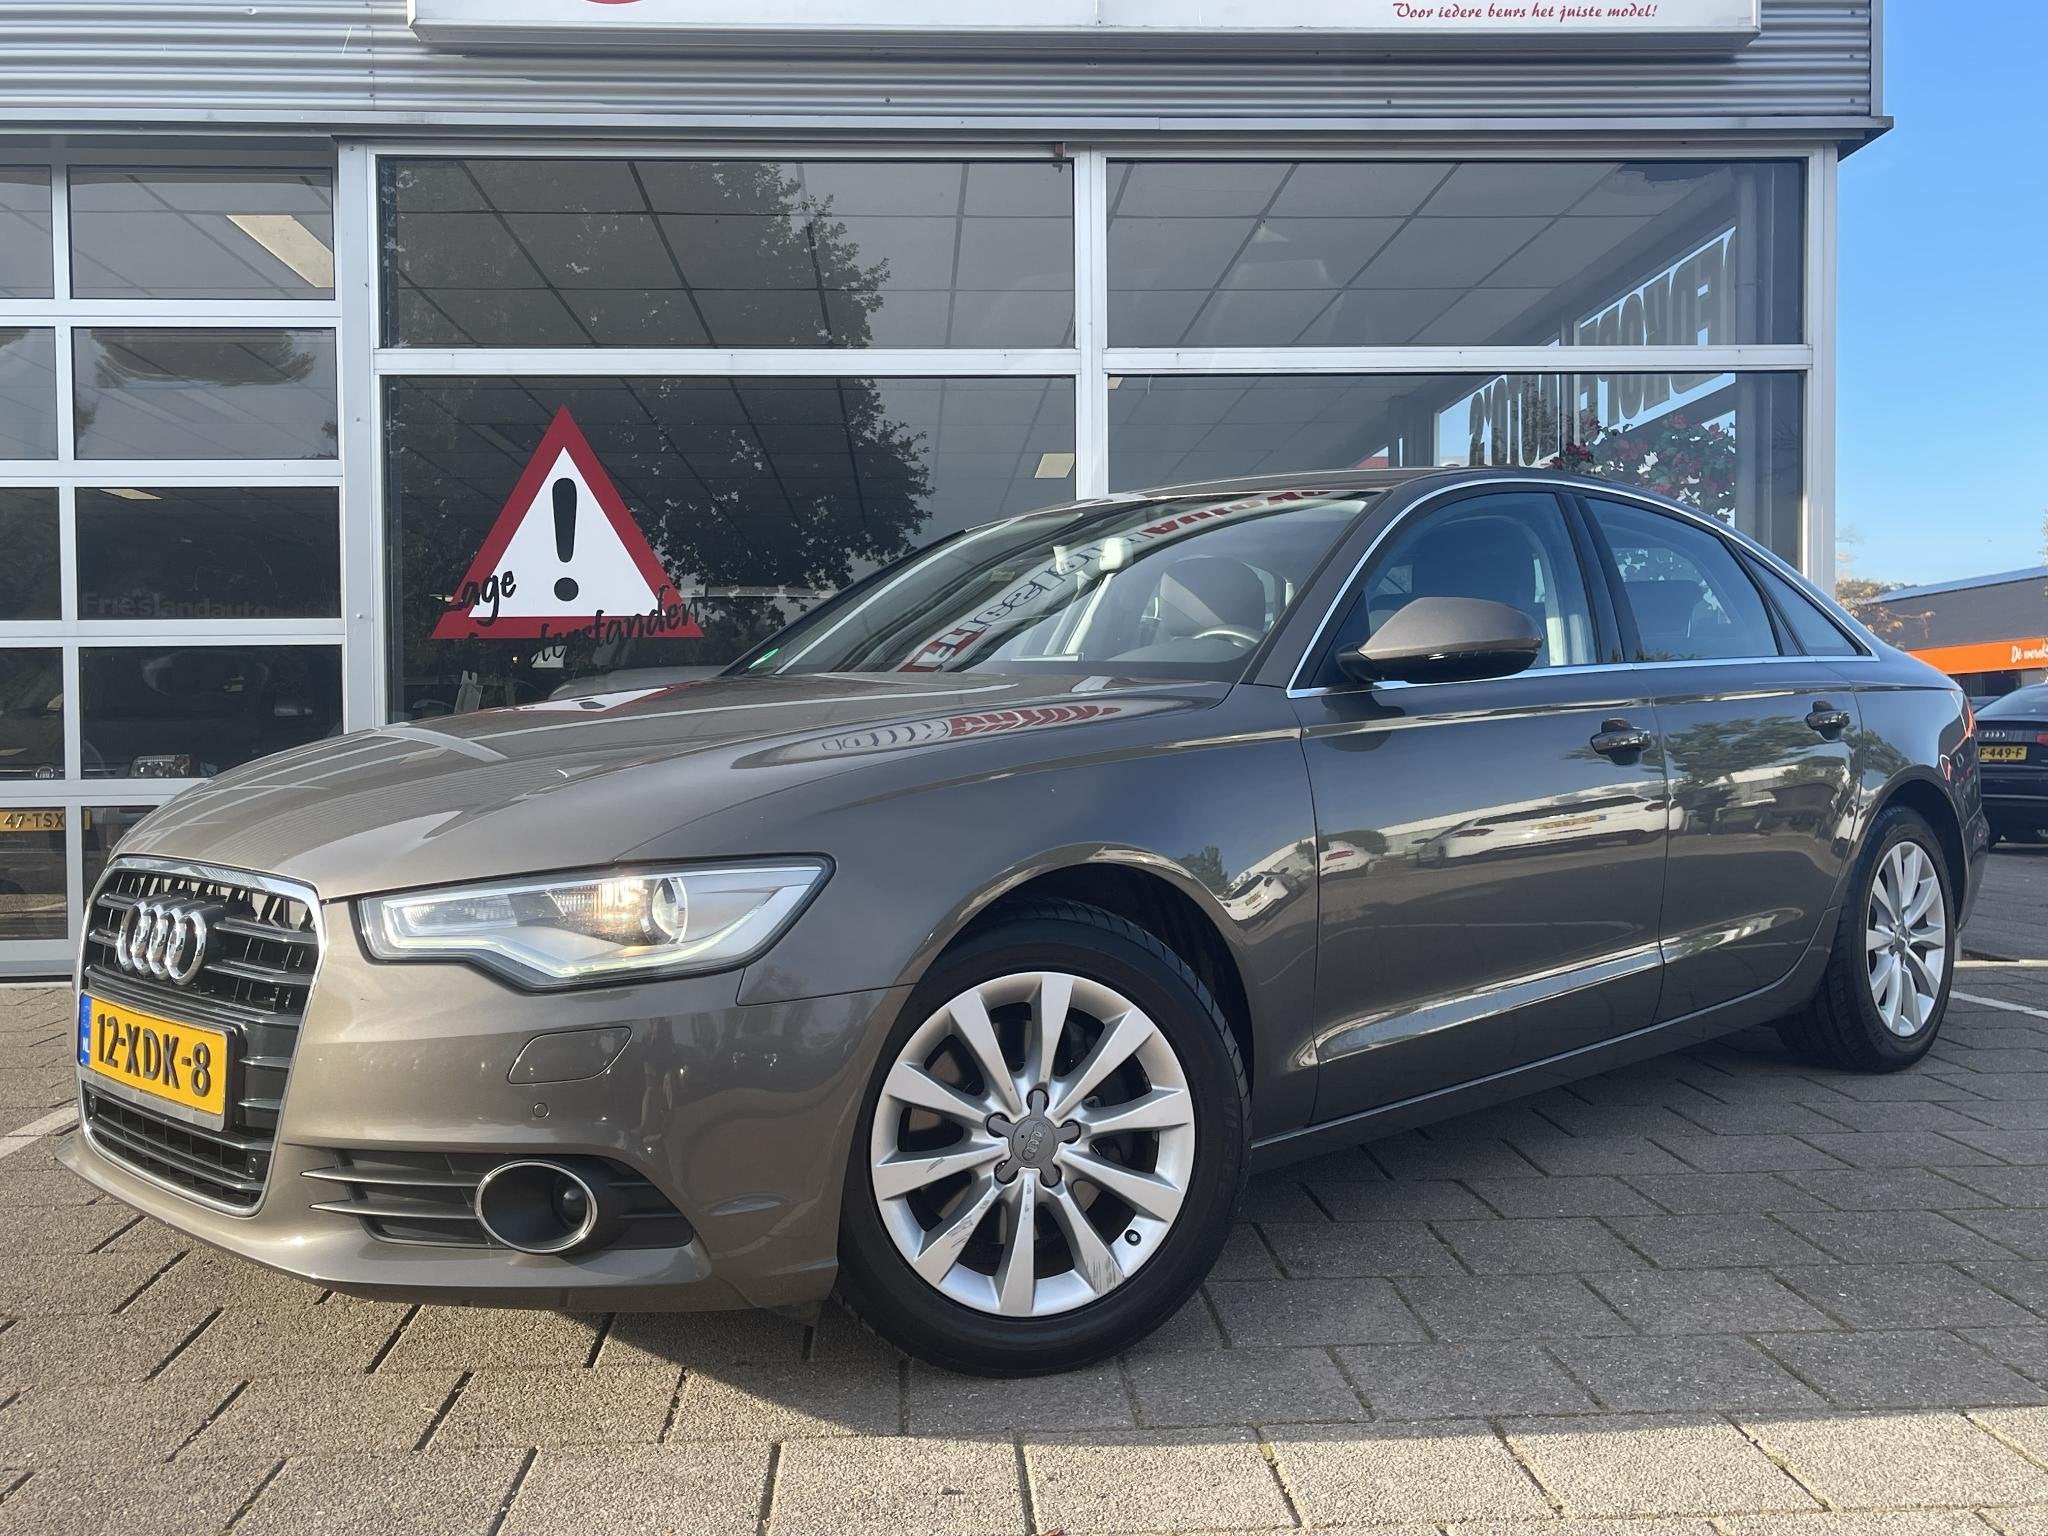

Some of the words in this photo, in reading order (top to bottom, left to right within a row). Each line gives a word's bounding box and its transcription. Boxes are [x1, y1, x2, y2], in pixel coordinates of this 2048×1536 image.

[1393, 3, 1433, 18] Voor
[1438, 3, 1482, 18] iedere
[1487, 3, 1526, 17] beurs
[1532, 3, 1554, 17] het
[1560, 4, 1602, 22] juiste
[1607, 3, 1657, 17] model!
[97, 1013, 211, 1098] 12-XDK-8
